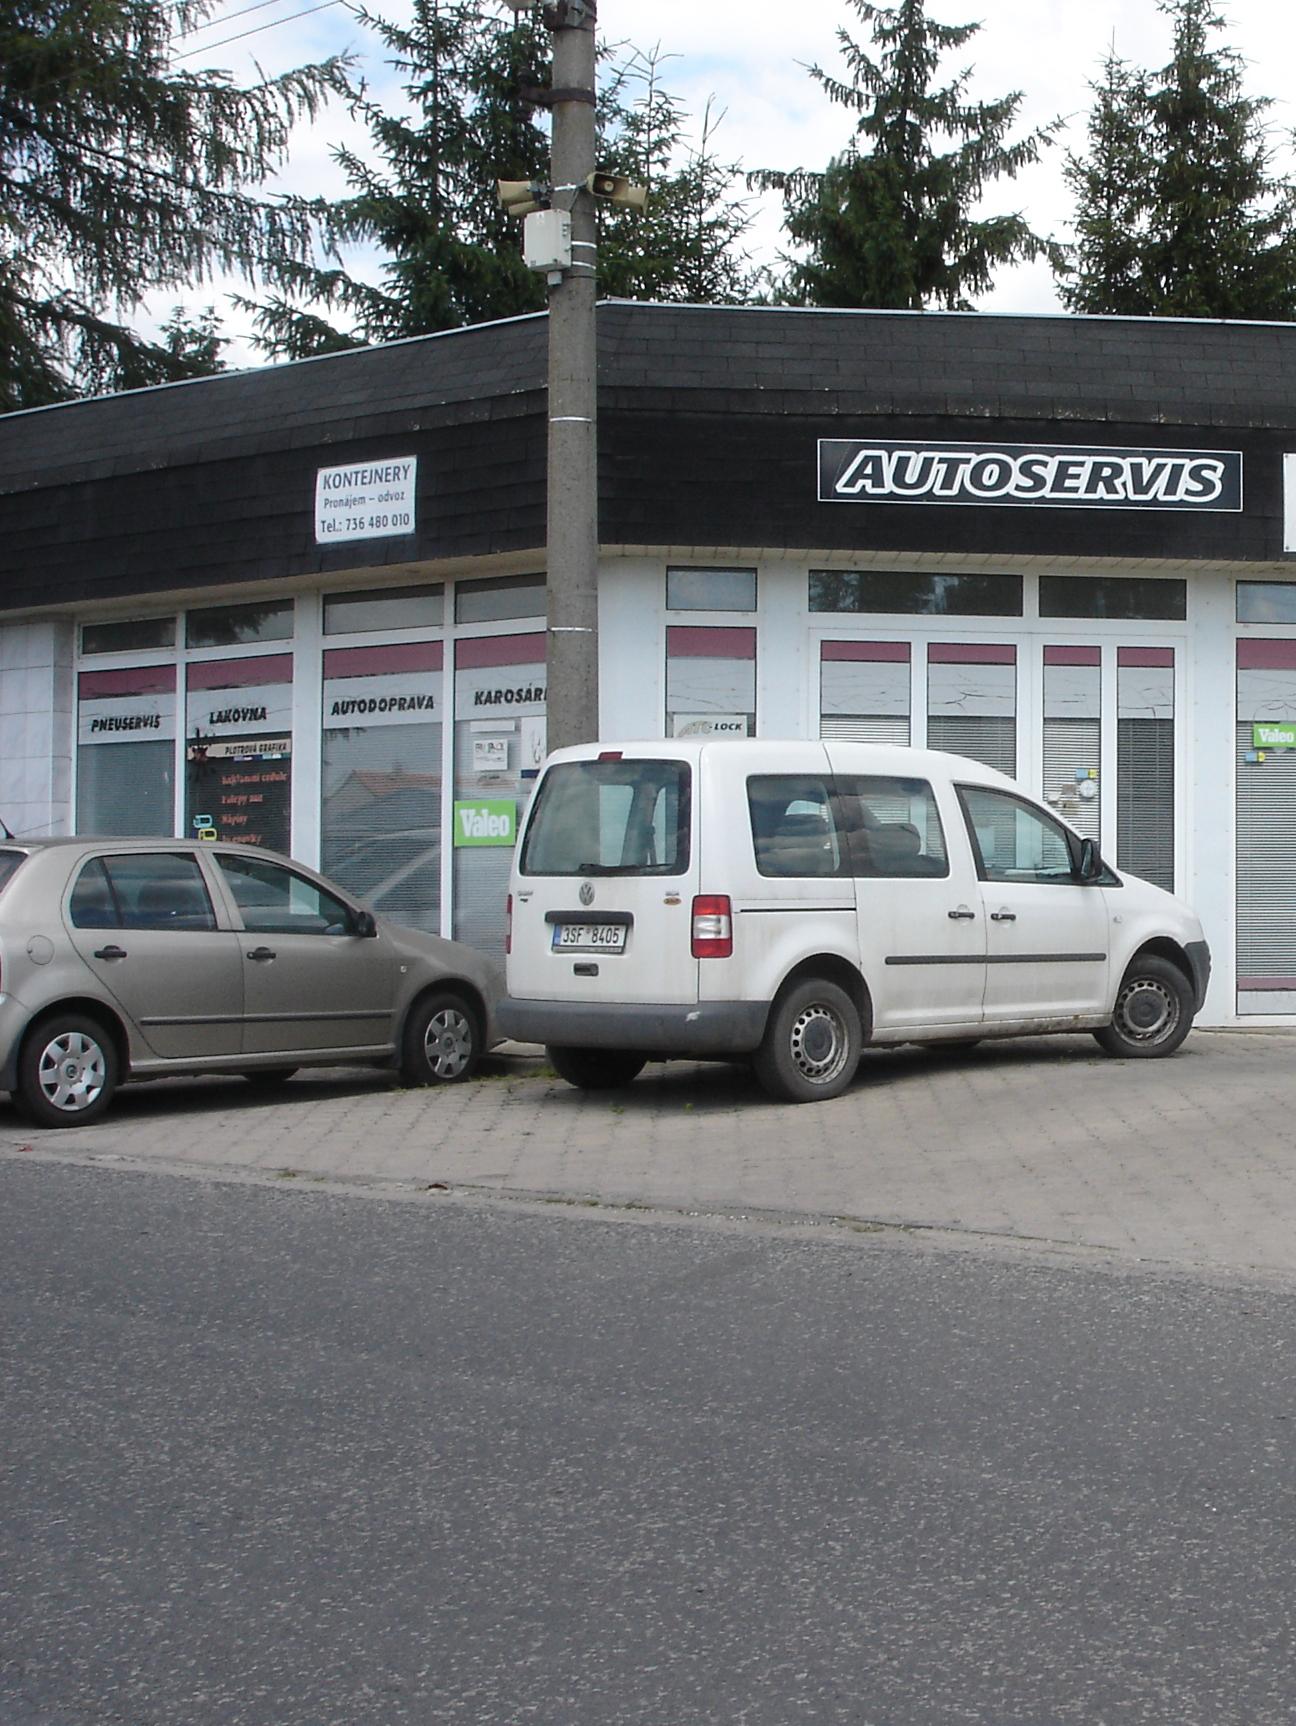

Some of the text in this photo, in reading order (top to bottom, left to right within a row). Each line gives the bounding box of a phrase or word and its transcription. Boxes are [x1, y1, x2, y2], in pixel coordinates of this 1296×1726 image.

[323, 464, 411, 490] KONTEJNERY
[836, 450, 1225, 502] AUTOSERVIS
[324, 494, 366, 509] Pronájem
[377, 490, 405, 503] odvoz
[321, 513, 410, 533] Tel.: 736 480 010
[474, 682, 547, 706] KAROSÁR
[209, 707, 267, 724] LAKOVNA
[331, 695, 434, 716] AUTODOPRAVA
[91, 714, 161, 732] PNEUSERVIS
[1258, 727, 1294, 743] Valeo
[459, 808, 511, 838] Valeo
[563, 927, 620, 944] 3SF 8405
